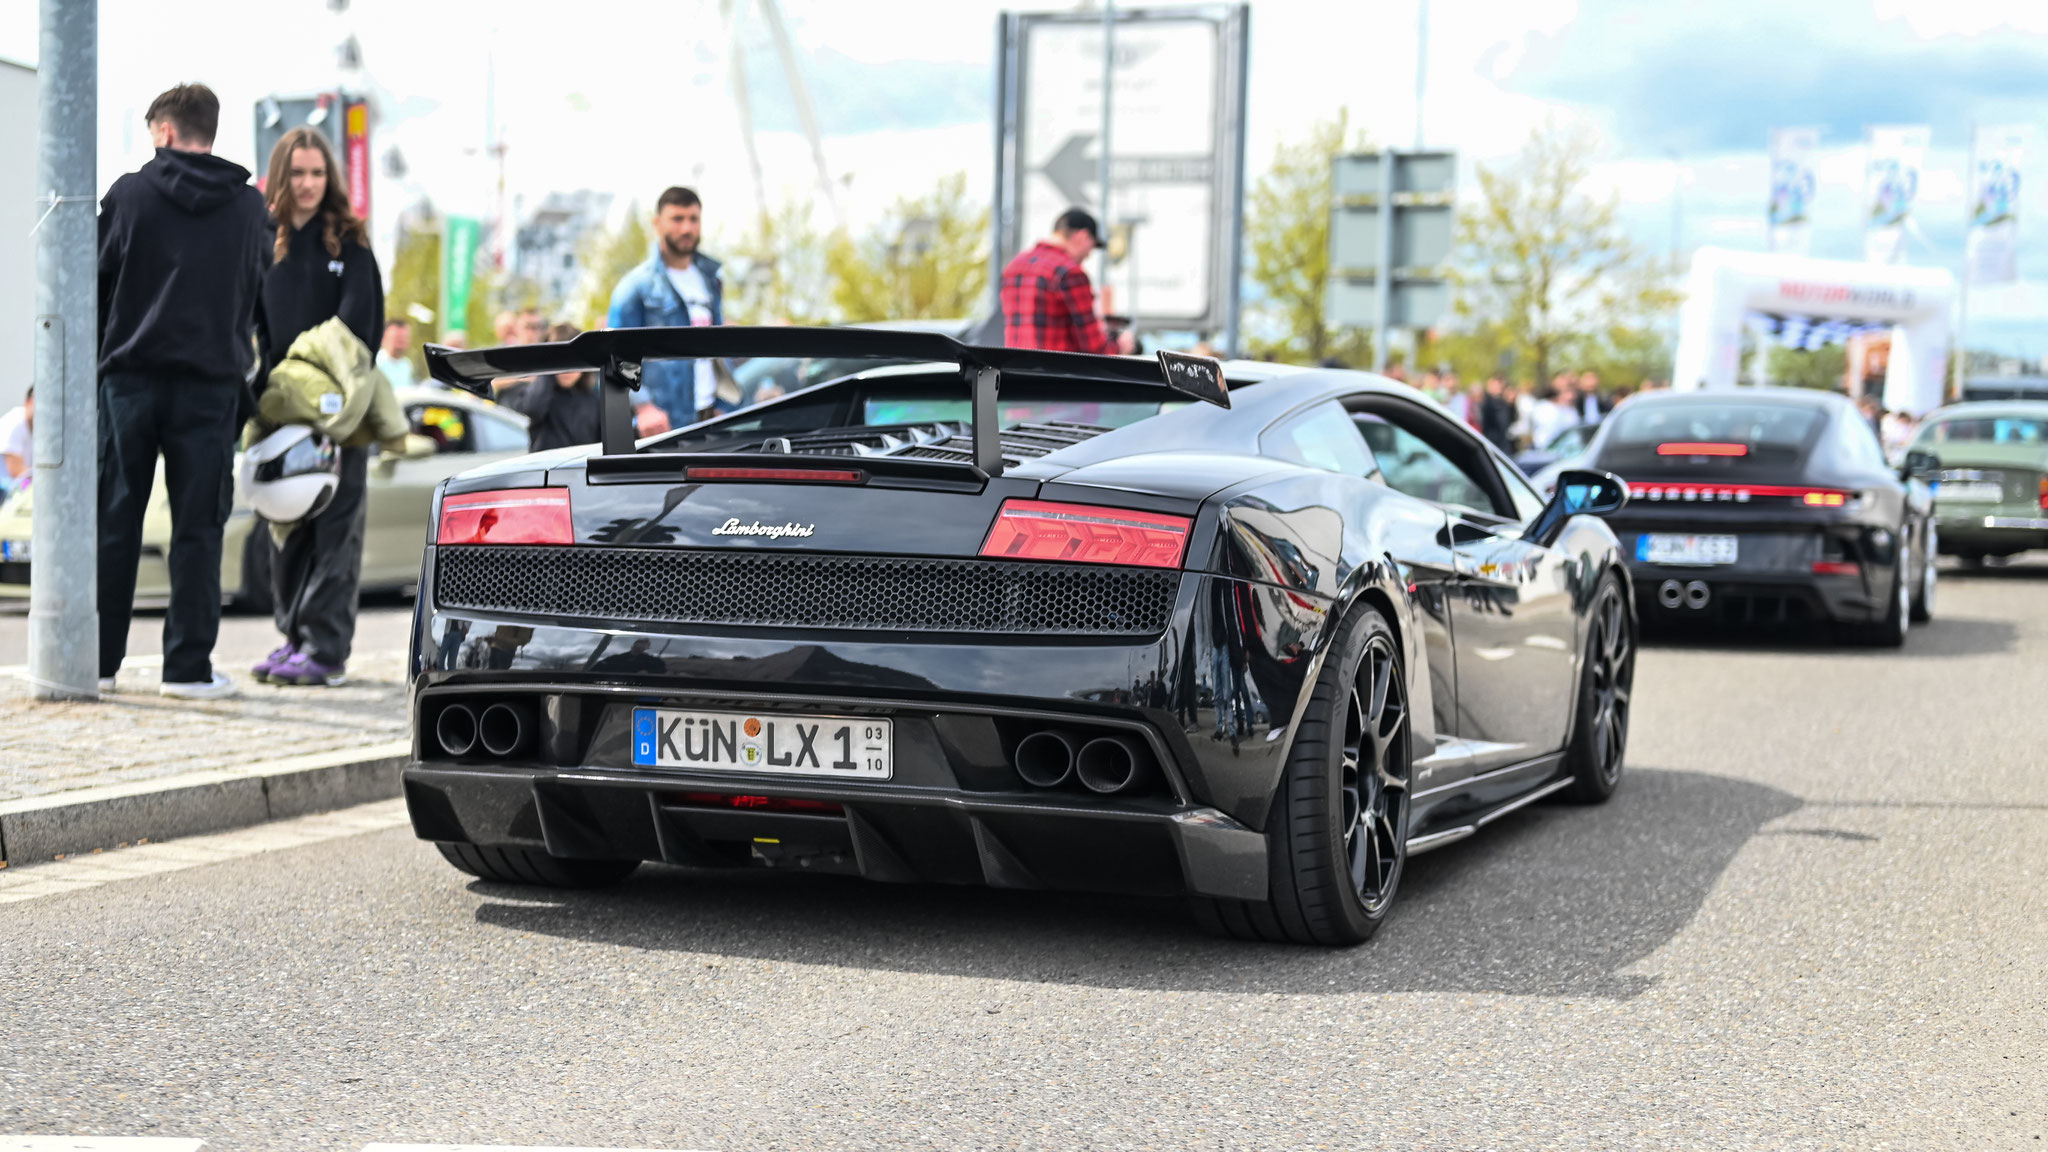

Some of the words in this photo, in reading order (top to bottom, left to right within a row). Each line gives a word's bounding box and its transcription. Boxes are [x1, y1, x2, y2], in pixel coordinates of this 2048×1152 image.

[712, 517, 815, 540] Lamborghini
[865, 726, 883, 740] 03
[640, 742, 650, 756] D
[866, 757, 883, 771] 10
